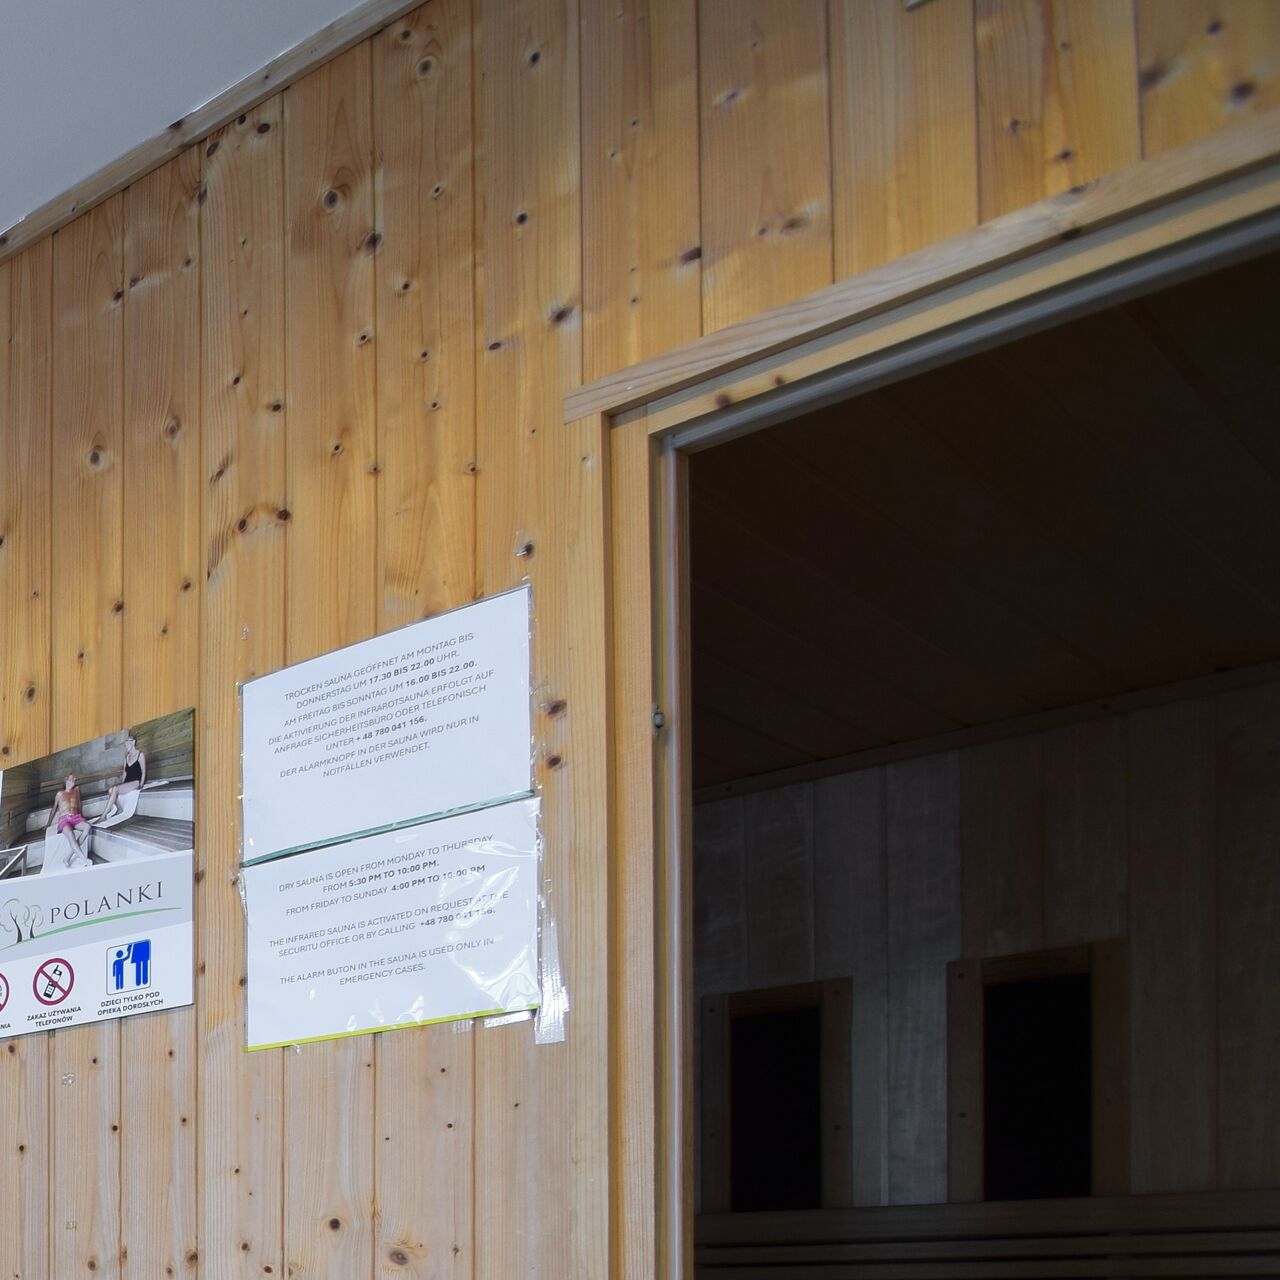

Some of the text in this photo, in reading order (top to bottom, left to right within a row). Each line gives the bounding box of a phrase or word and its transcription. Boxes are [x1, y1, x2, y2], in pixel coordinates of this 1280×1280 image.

[284, 632, 474, 701] TROCKEN SAUNA GEÖFFNET AM MONTAG BIS
[296, 684, 352, 709] DONNERSTAG
[353, 679, 367, 690] UM
[369, 671, 392, 685] 17.30
[393, 665, 409, 677] BIS
[410, 657, 435, 672] 22.00
[268, 669, 494, 746] DIE AKTIVIERUNG DER INFRAROTSAUNA ERFOLGT AUF
[284, 660, 478, 727] AM FREITAG BIS SONNTAG UM 16.00 BIS 22.00.
[274, 737, 313, 755] ANFRAGE
[394, 704, 420, 719] ODER
[422, 684, 487, 710] TELEFONISCH
[326, 737, 354, 751] UNTER
[362, 731, 373, 740] 48
[374, 726, 390, 737] 780
[391, 721, 406, 732] 041
[409, 715, 427, 726] 156.
[279, 714, 479, 778] DER ALARMKNOPF IN DER SAUNA WIRD NUR IN
[373, 741, 429, 764] VERWENDET.
[279, 882, 295, 893] DRY
[296, 875, 325, 888] SAUNA
[325, 872, 334, 881] IS
[334, 866, 359, 879] OPEN
[360, 859, 385, 872] FROM
[386, 849, 426, 866] MONDAY
[427, 846, 440, 856] TO
[323, 860, 440, 893] FROM 5:30 PM TO 10:00 PM.
[49, 881, 163, 924] POLANKI
[286, 904, 309, 916] FROM
[310, 898, 339, 911] FRIDAY
[340, 895, 352, 904] TO
[353, 886, 388, 901] SUNDAY
[391, 881, 410, 891] 4:00
[411, 877, 426, 887] PM
[427, 874, 440, 884] TO
[269, 897, 474, 948] THE INFRARED SAUNA IS ACTIVATED ON REQUEST
[319, 935, 351, 949] OFFICE
[351, 933, 365, 943] OR
[366, 930, 377, 939] BY
[377, 922, 416, 937] CALLING
[437, 914, 455, 924] 780
[280, 938, 494, 985] THE ALARM BUTON IN THE SAUNA IS USED ONLY IN
[339, 963, 426, 986] EMERGENCY CASES.
